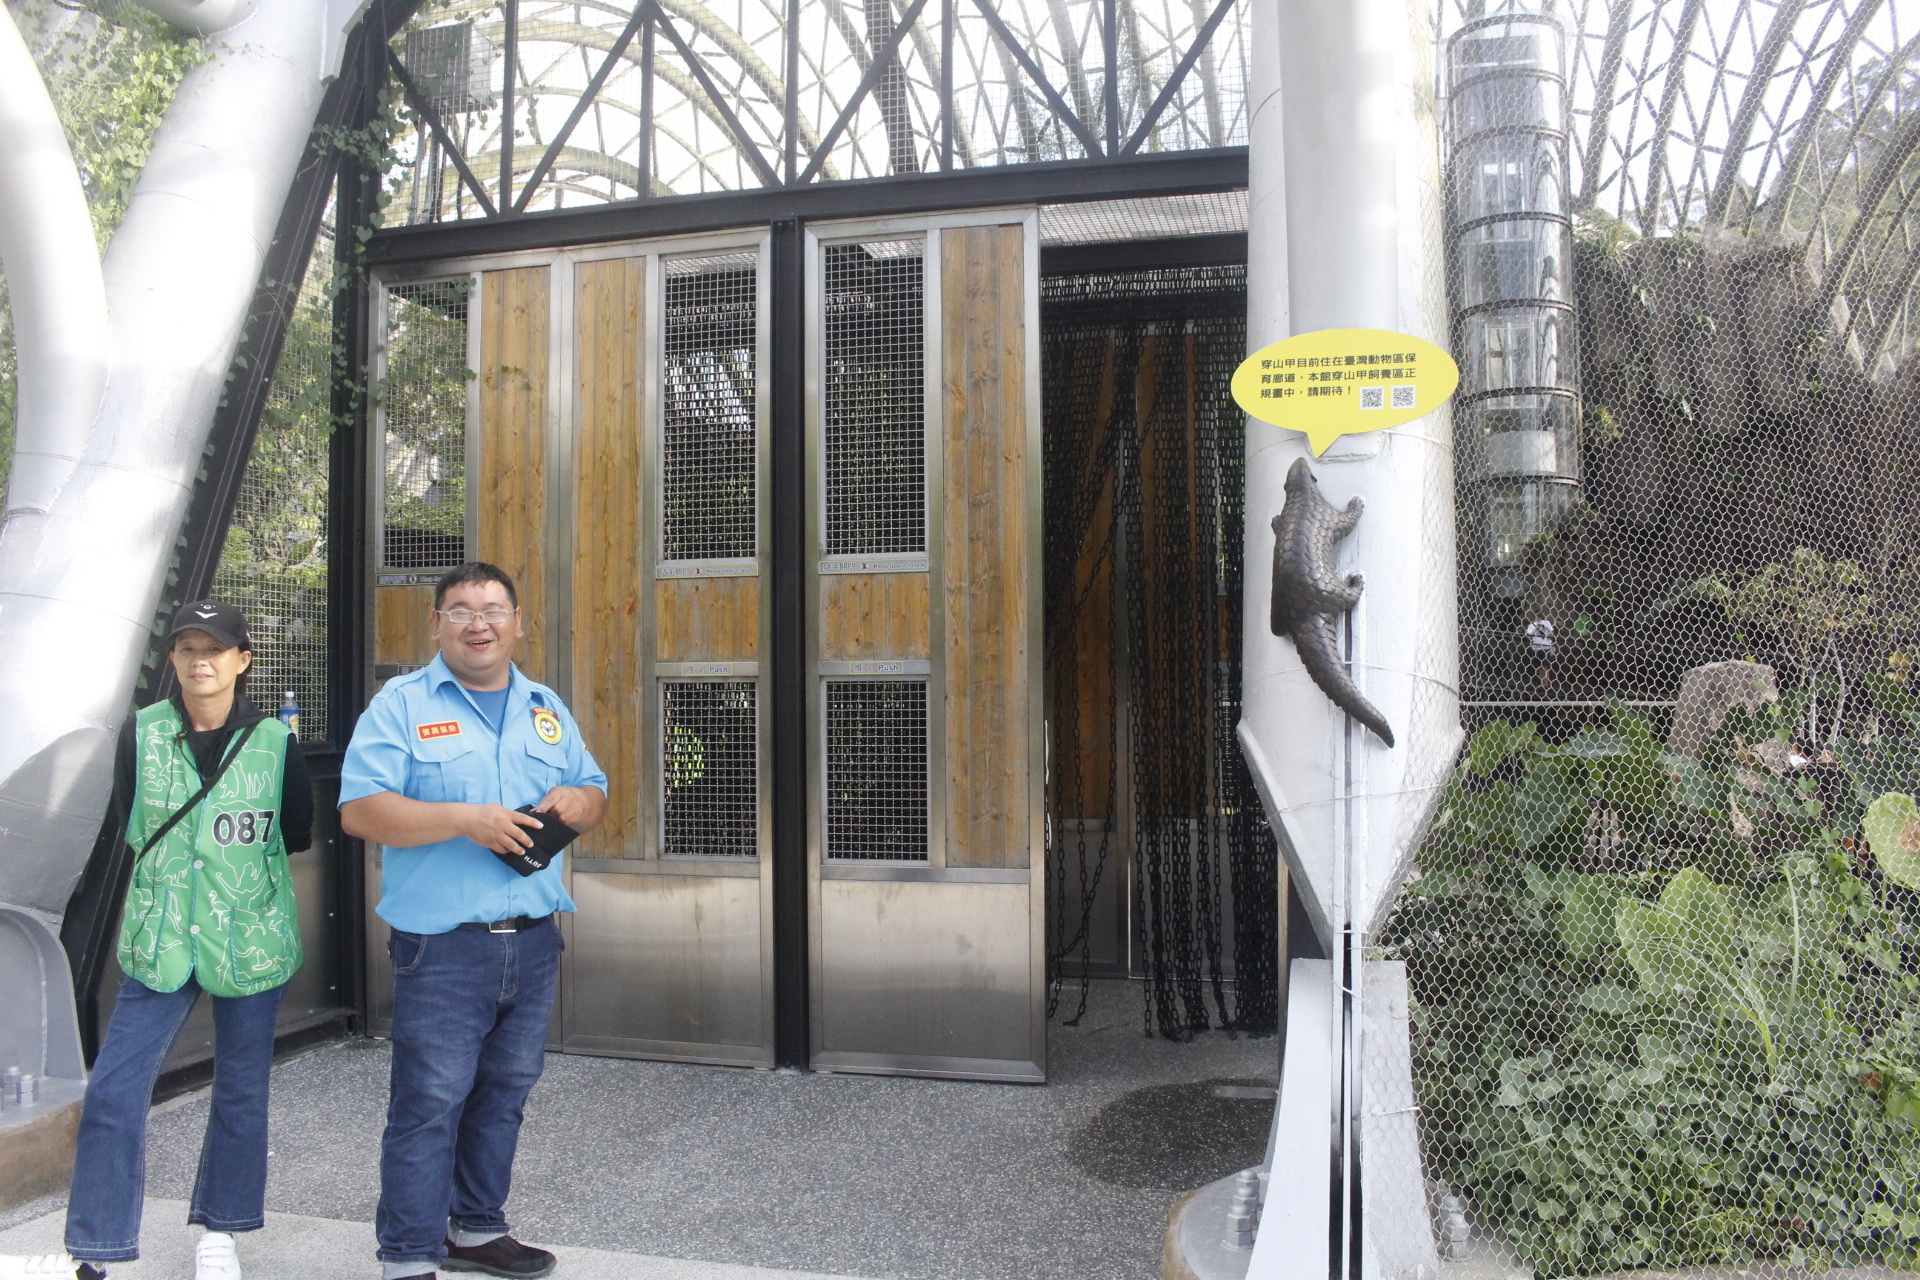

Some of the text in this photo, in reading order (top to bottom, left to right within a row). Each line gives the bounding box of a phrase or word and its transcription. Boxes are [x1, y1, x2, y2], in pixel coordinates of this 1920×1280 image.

[1261, 353, 1417, 370] 穿山甲目前住在臺灣動物區保
[1260, 367, 1417, 384] 育廊道，本館穿山甲飼養區正
[709, 665, 728, 673] Push
[212, 810, 275, 847] 087
